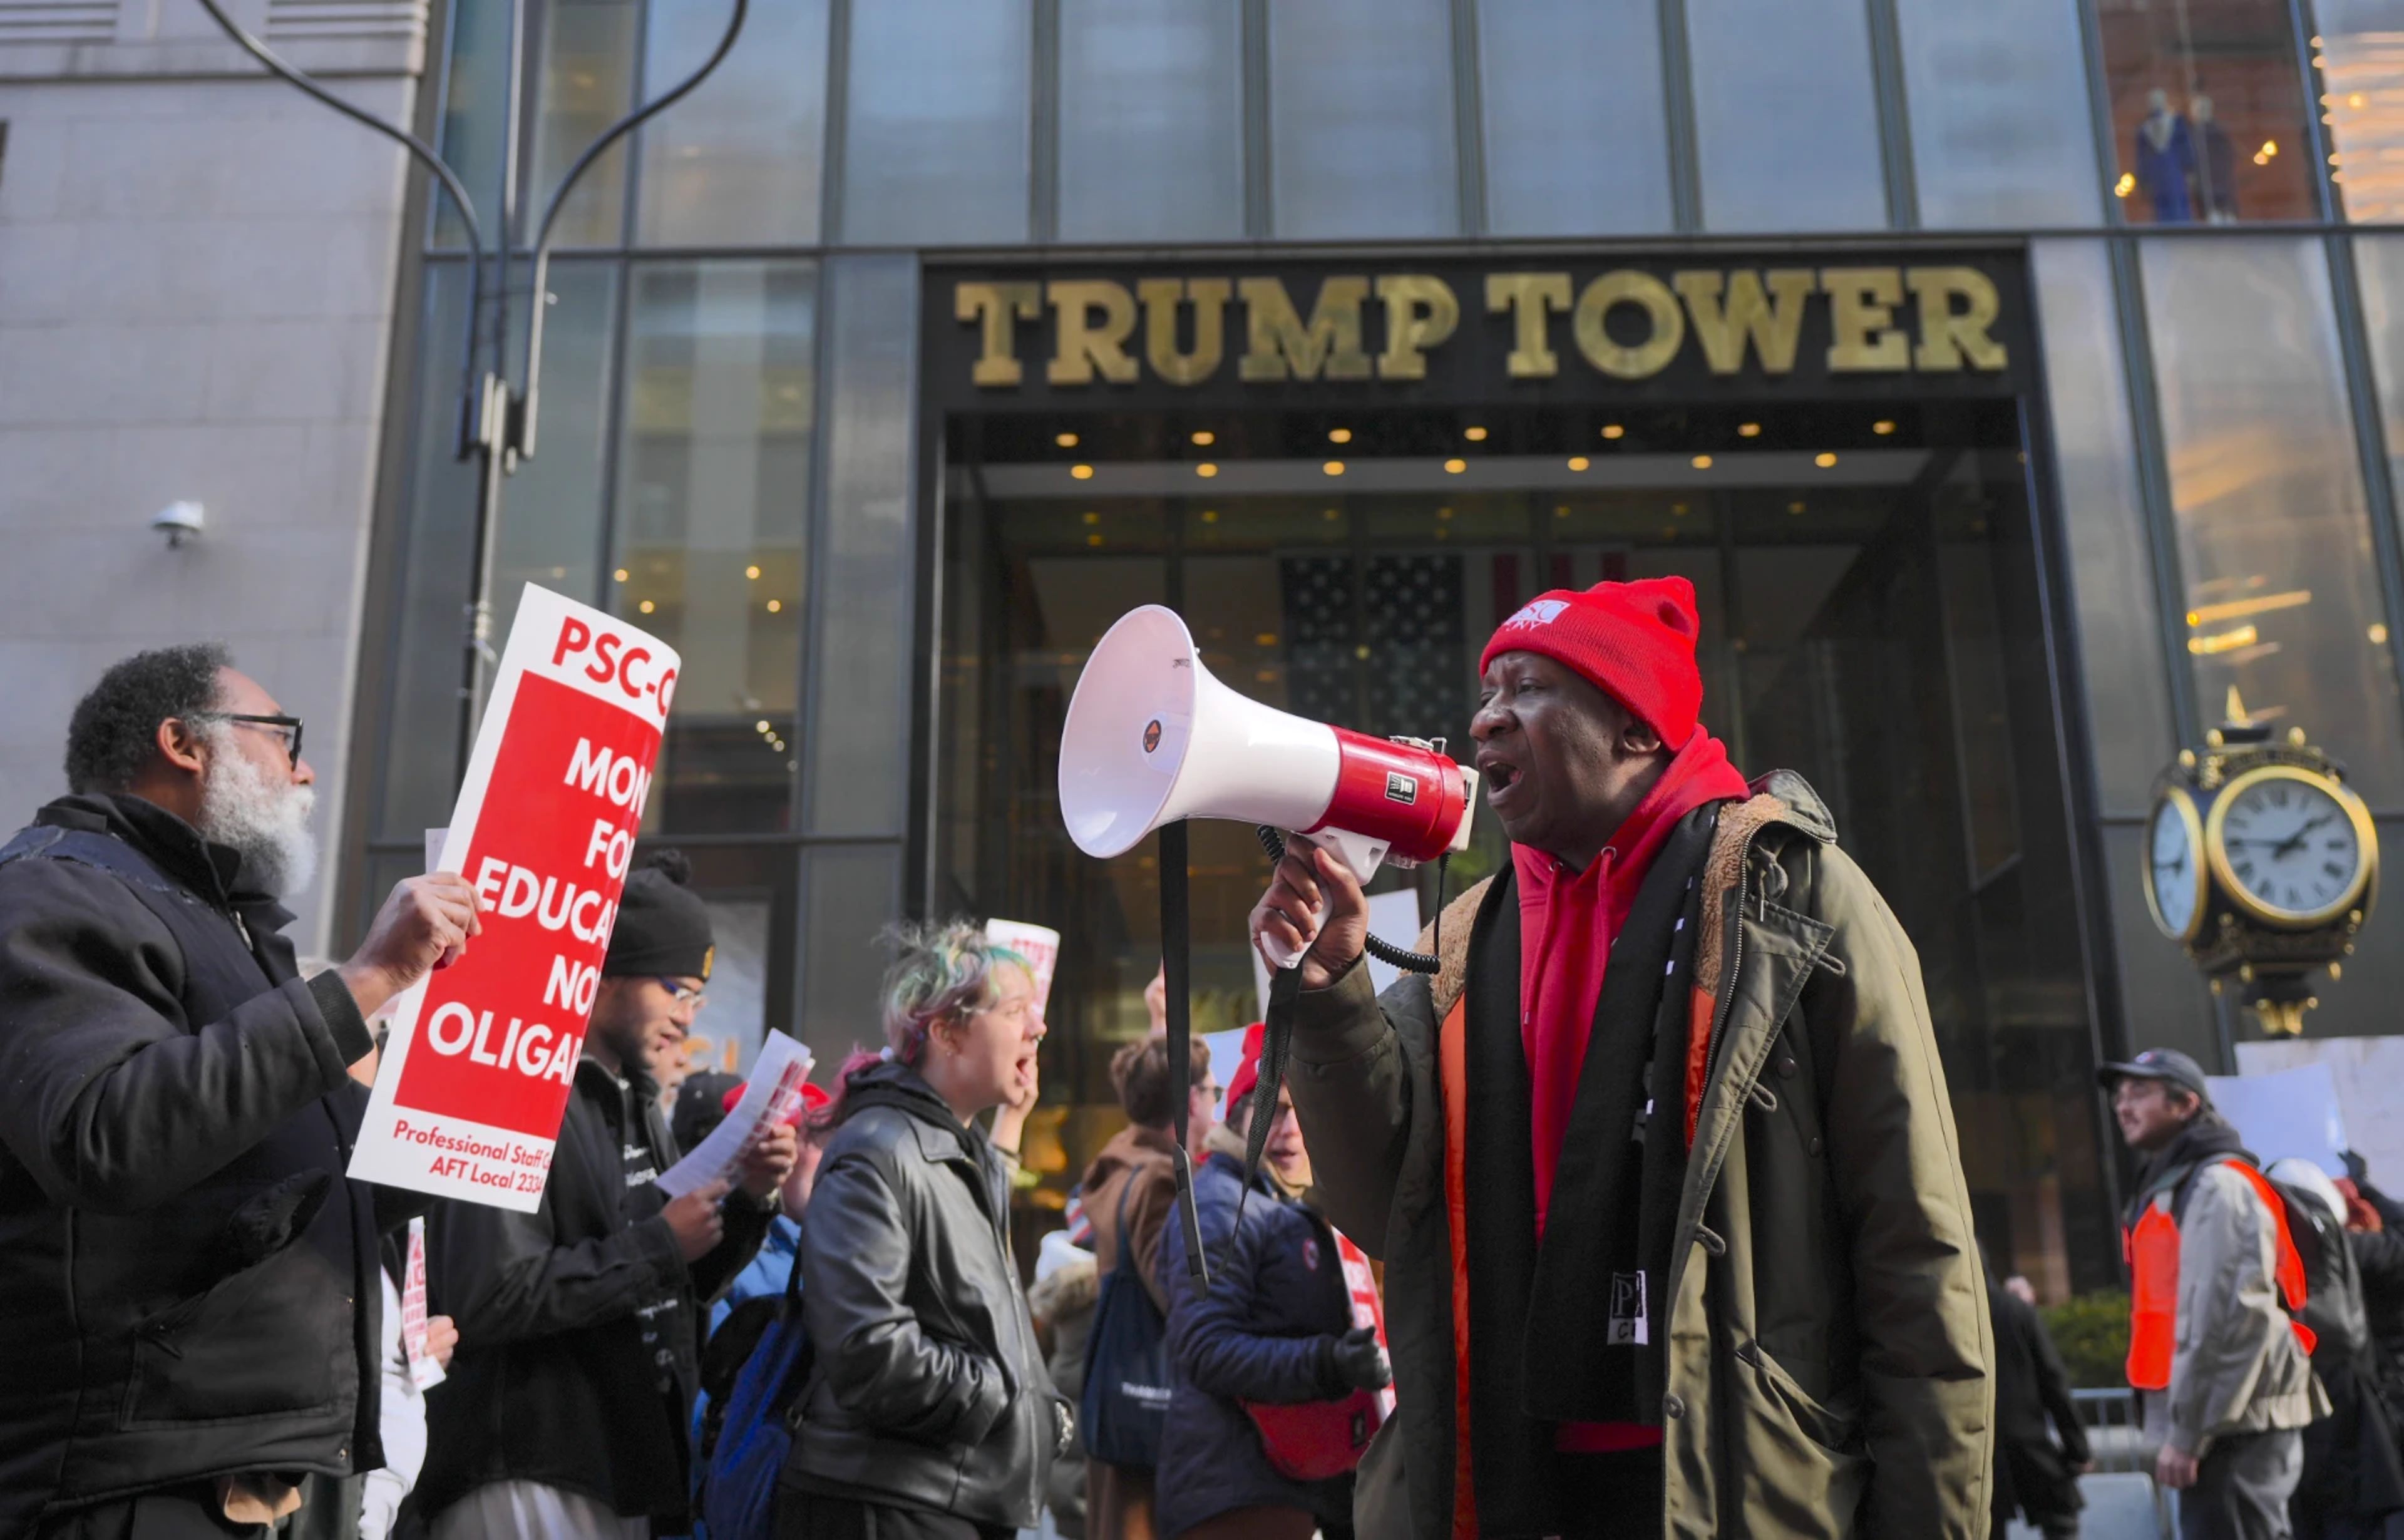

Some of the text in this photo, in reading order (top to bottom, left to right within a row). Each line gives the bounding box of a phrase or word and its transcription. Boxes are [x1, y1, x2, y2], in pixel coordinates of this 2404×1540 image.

[955, 266, 2009, 386] TRUMP TOWER
[474, 855, 619, 952] EDUCA
[393, 1119, 510, 1161] Professional
[510, 1145, 545, 1169] Staff
[429, 1156, 469, 1179] AFT
[470, 1163, 516, 1189] Local
